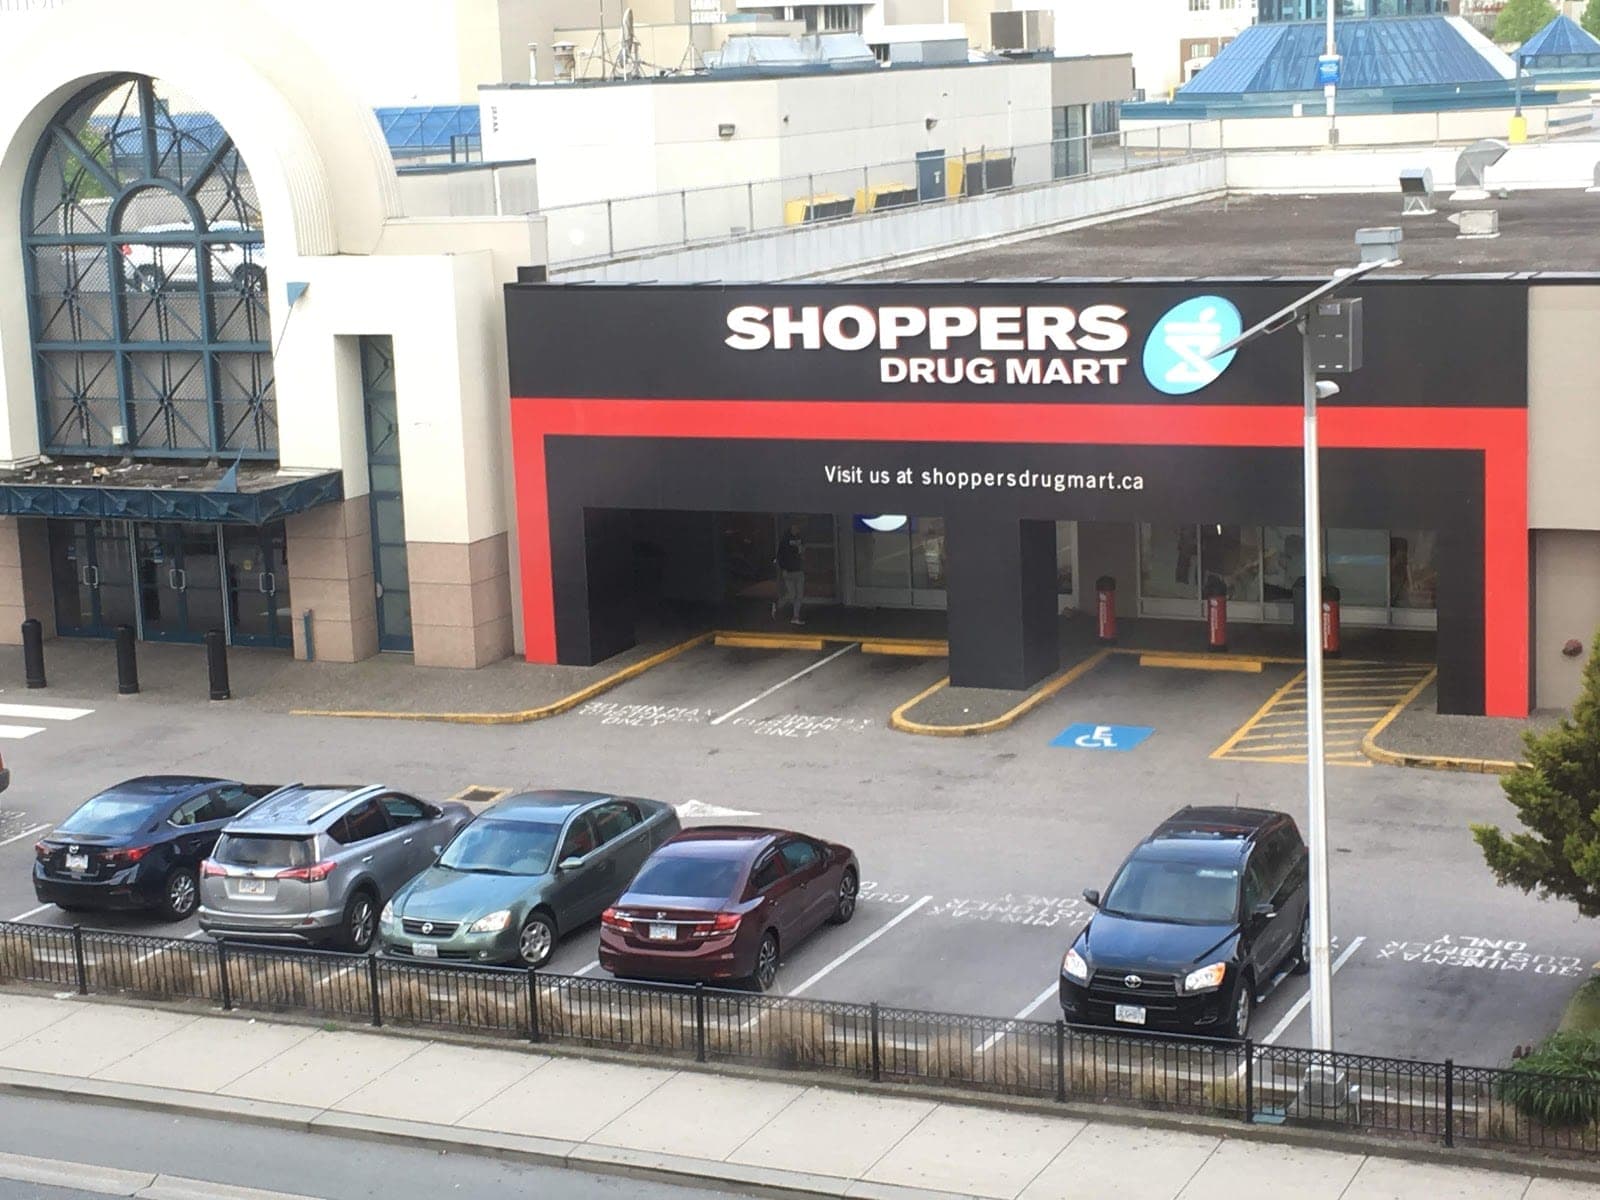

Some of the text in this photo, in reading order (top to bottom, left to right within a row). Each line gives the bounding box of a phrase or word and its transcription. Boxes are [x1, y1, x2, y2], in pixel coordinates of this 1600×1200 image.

[725, 305, 1128, 352] SHOPPERS
[880, 358, 1127, 386] DRUG MART
[824, 465, 1144, 492] Visit us at shoppersdrugmart.ca
[1433, 933, 1528, 952] ONLY
